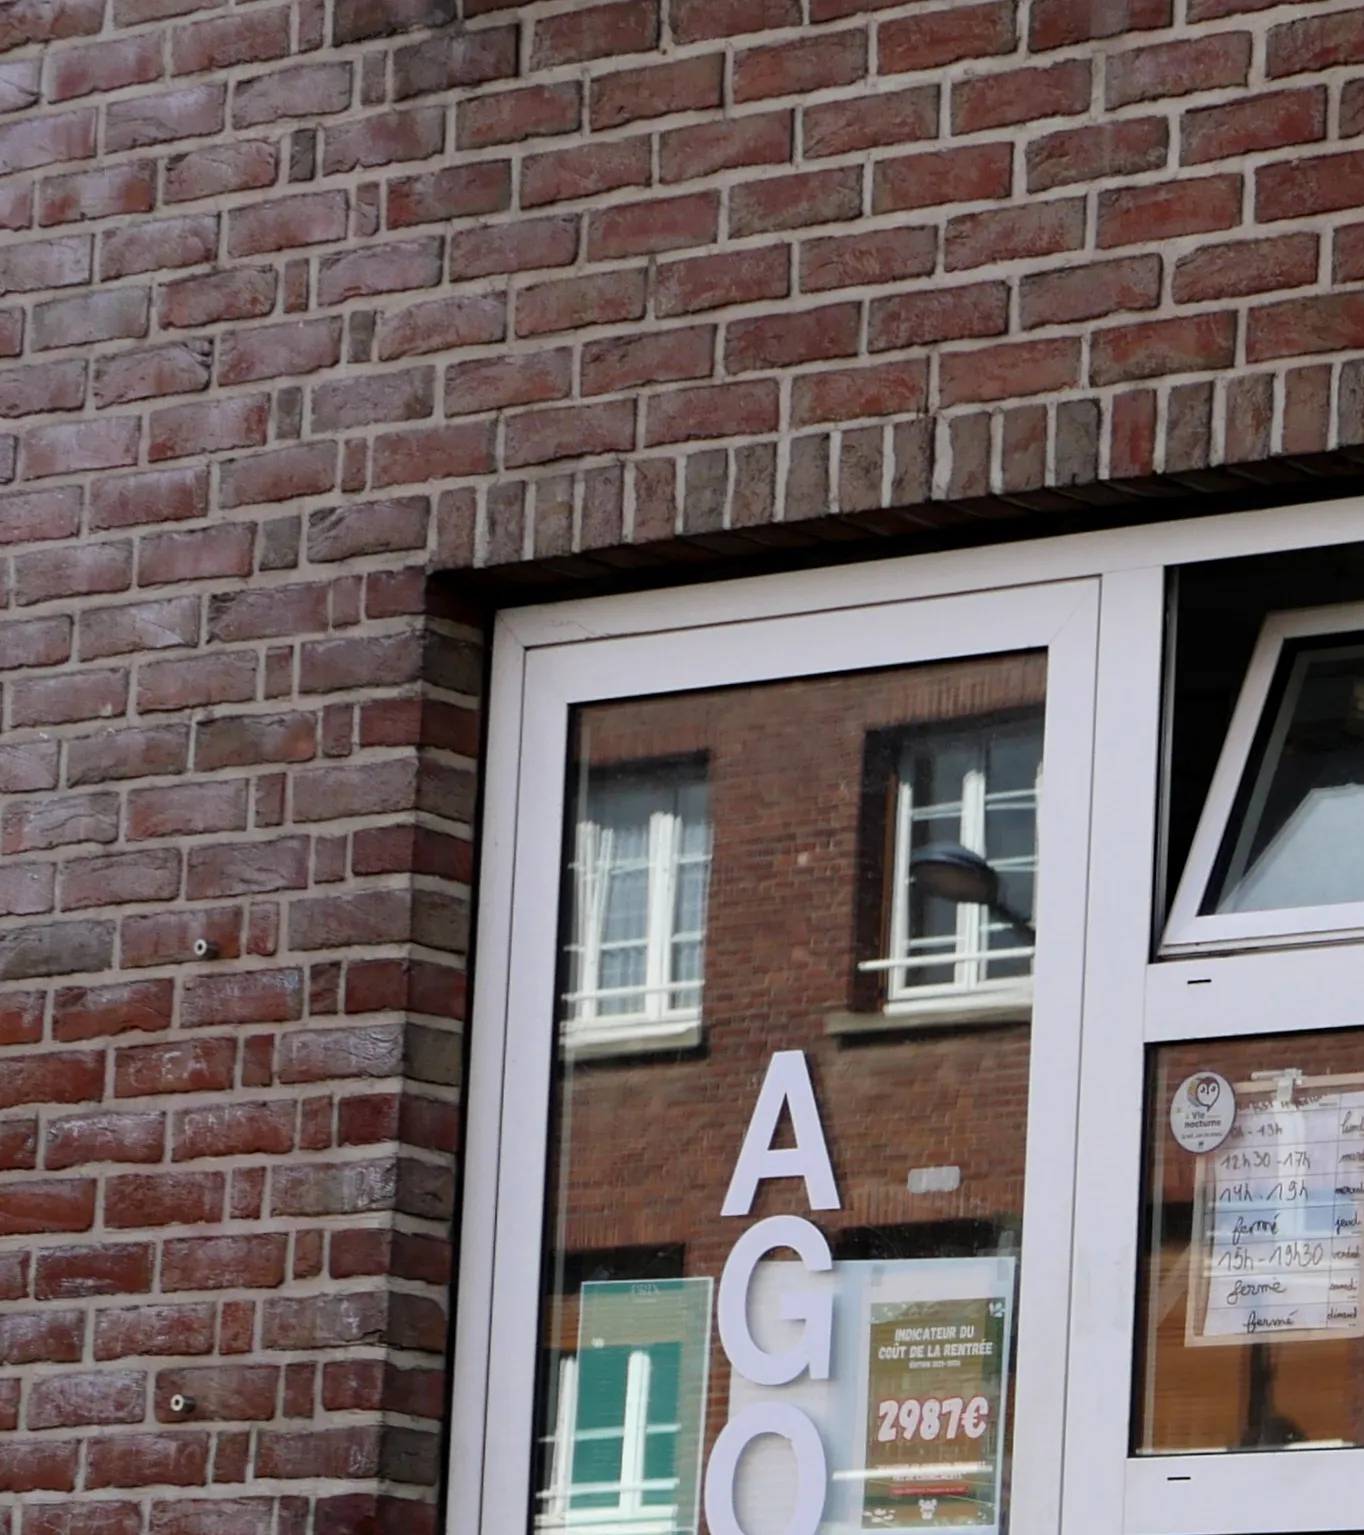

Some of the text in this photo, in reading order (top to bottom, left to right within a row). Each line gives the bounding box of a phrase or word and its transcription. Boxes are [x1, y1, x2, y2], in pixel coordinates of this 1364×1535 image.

[1184, 1118, 1222, 1129] nocturne
[1220, 1150, 1311, 1171] 12h30 17h
[1219, 1179, 1309, 1203] 14h 19h
[1232, 1213, 1281, 1246] fermé
[1218, 1241, 1325, 1272] 15h 19h30
[1242, 1308, 1300, 1334] fermé
[894, 1325, 976, 1342] INDICATEUR DU
[878, 1338, 994, 1360] COÛT DE LA RENTRÉE
[876, 1395, 990, 1444] 2987€
